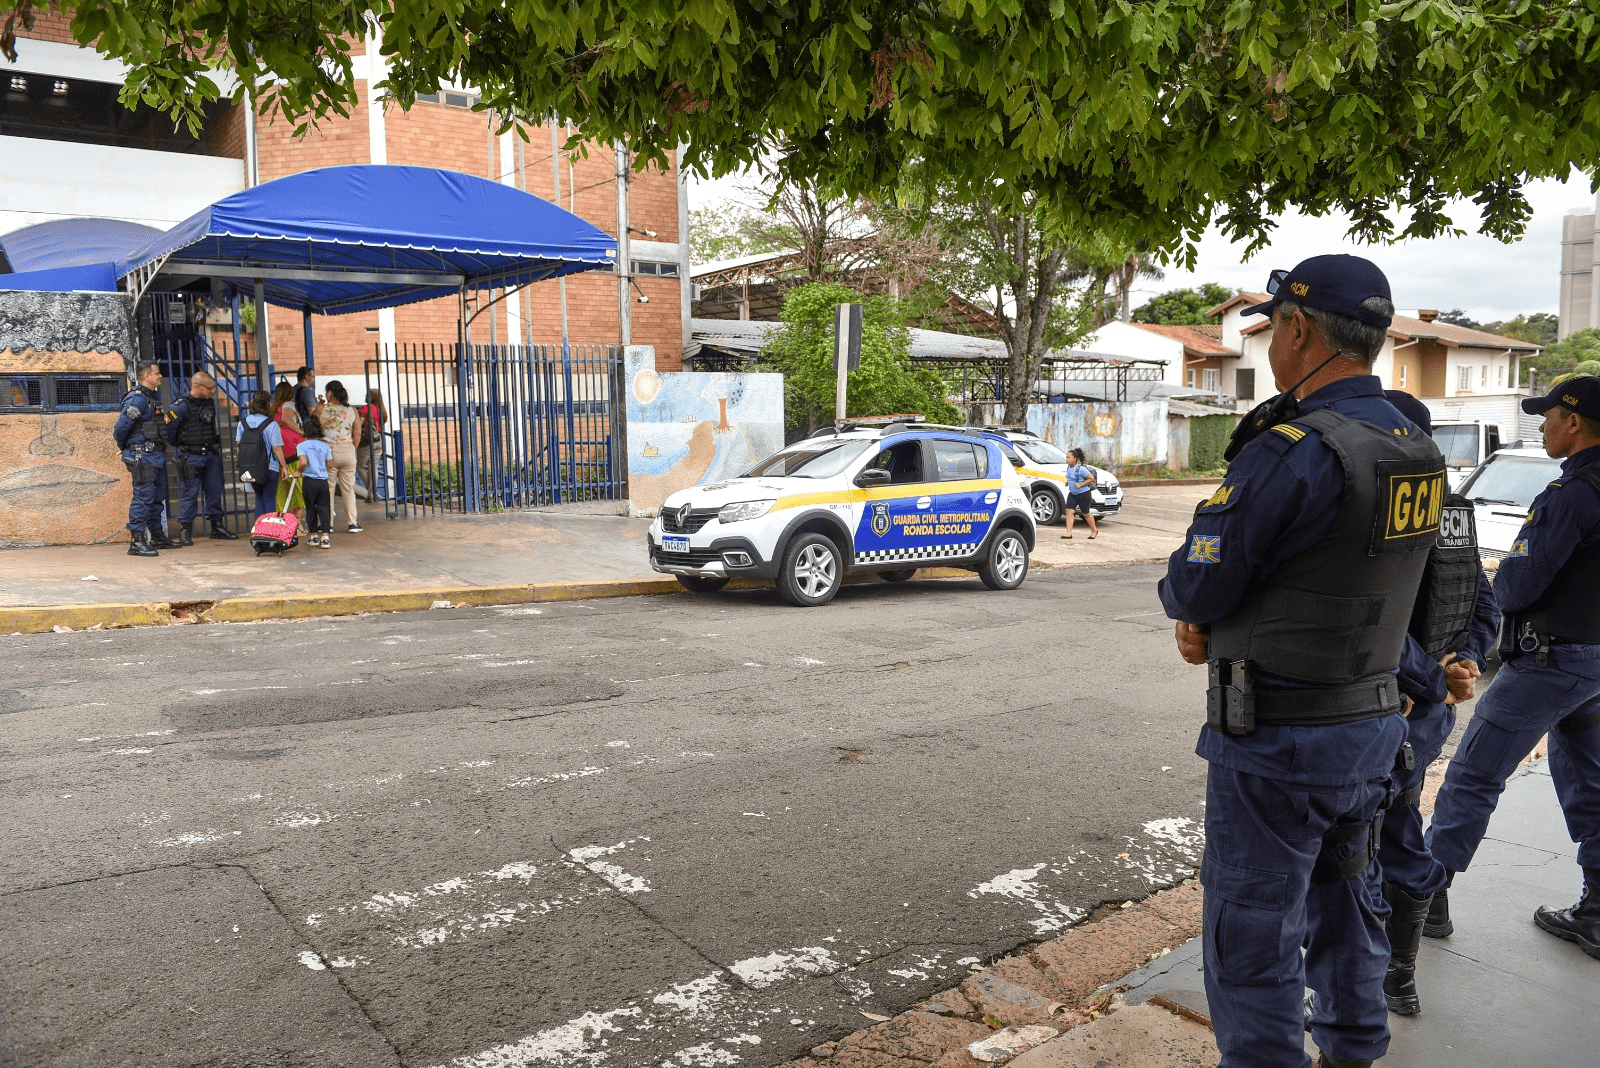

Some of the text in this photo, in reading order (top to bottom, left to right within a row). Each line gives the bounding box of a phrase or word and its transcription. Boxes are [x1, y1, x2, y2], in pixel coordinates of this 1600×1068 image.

[1290, 281, 1310, 297] GCM
[1562, 394, 1579, 407] GCM
[1394, 477, 1442, 532] GCM
[893, 512, 990, 525] GUARDA CIVIL METROPOLITANA
[1440, 509, 1469, 537] GCM
[903, 523, 972, 536] RONDA ESCOLAR
